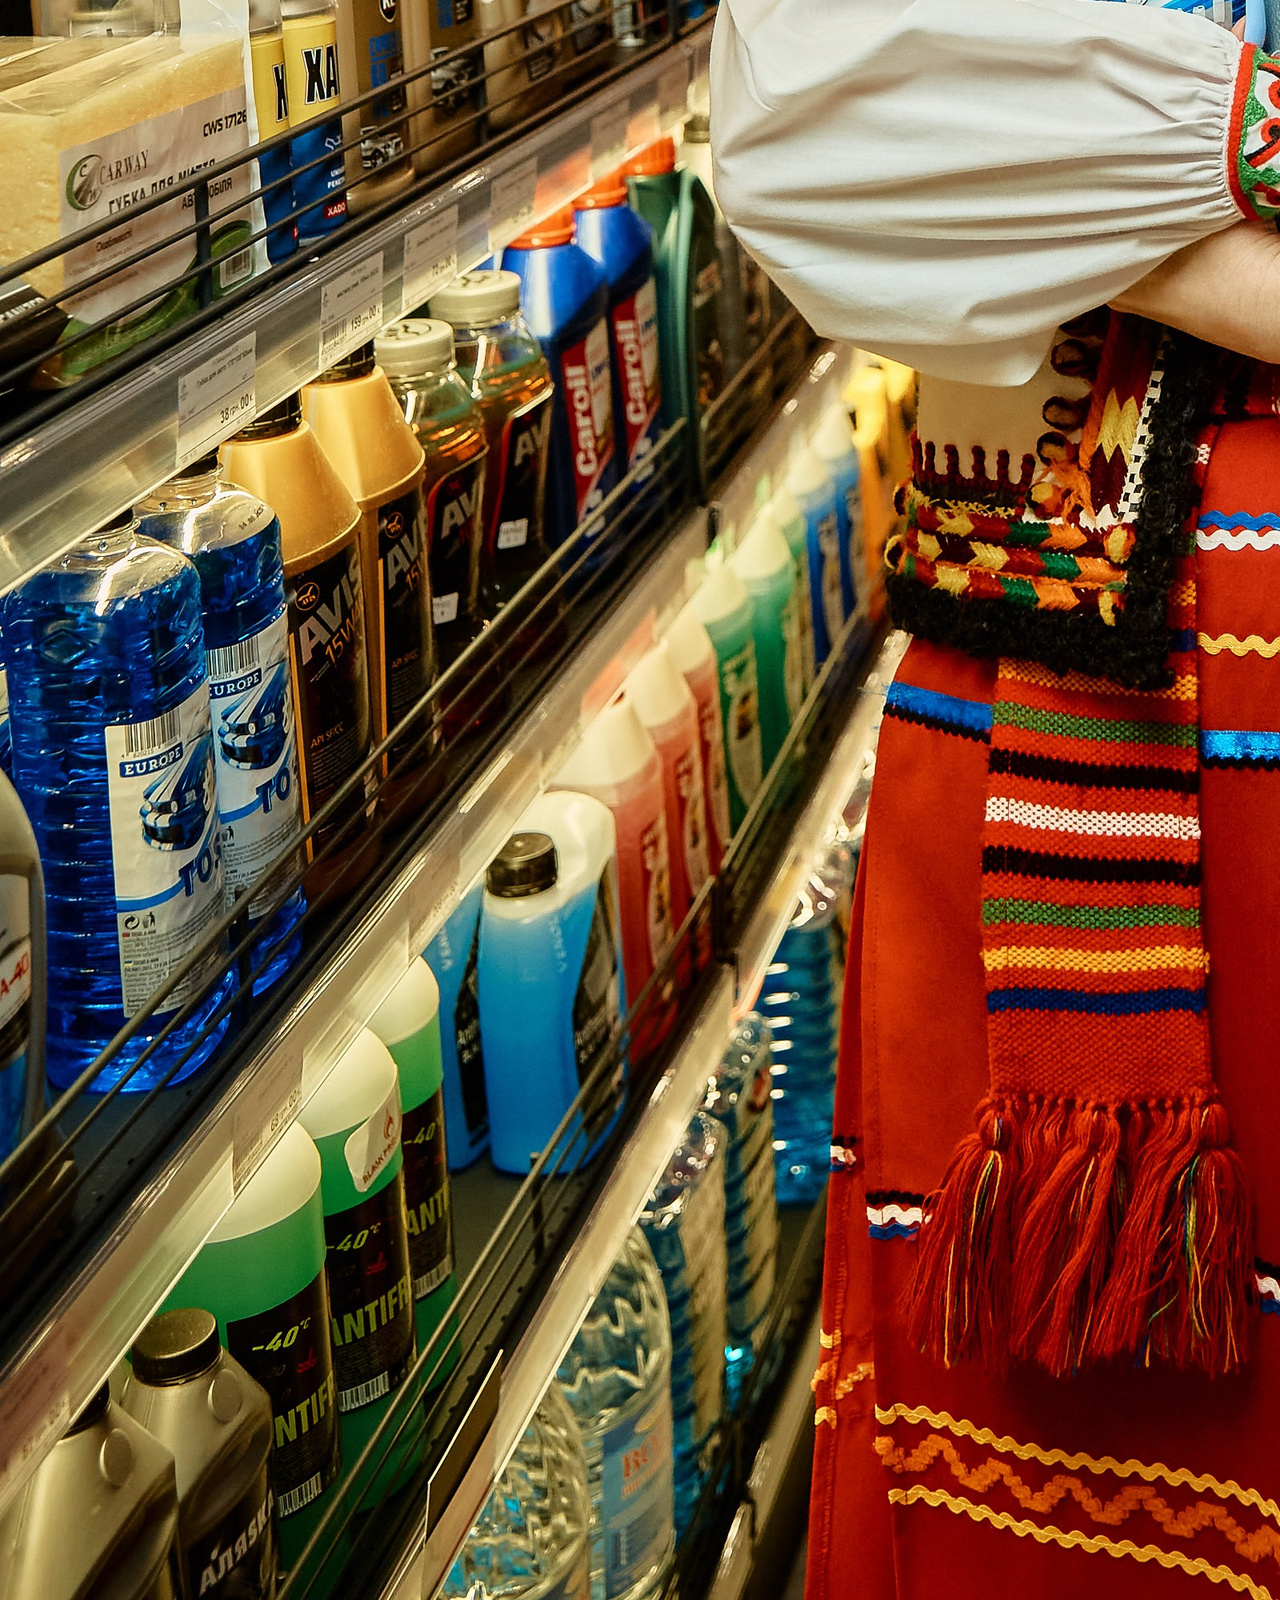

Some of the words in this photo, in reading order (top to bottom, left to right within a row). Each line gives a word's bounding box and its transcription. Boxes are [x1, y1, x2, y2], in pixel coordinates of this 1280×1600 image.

[100, 149, 149, 185] CARWAY
[616, 320, 648, 426] Caroil
[220, 407, 230, 424] 38
[240, 393, 249, 410] 00
[565, 364, 598, 477] Caroil
[124, 745, 181, 776] EUROPE
[256, 765, 294, 814] TO
[406, 1180, 450, 1237] ANTI
[274, 1368, 335, 1449] NTIF
